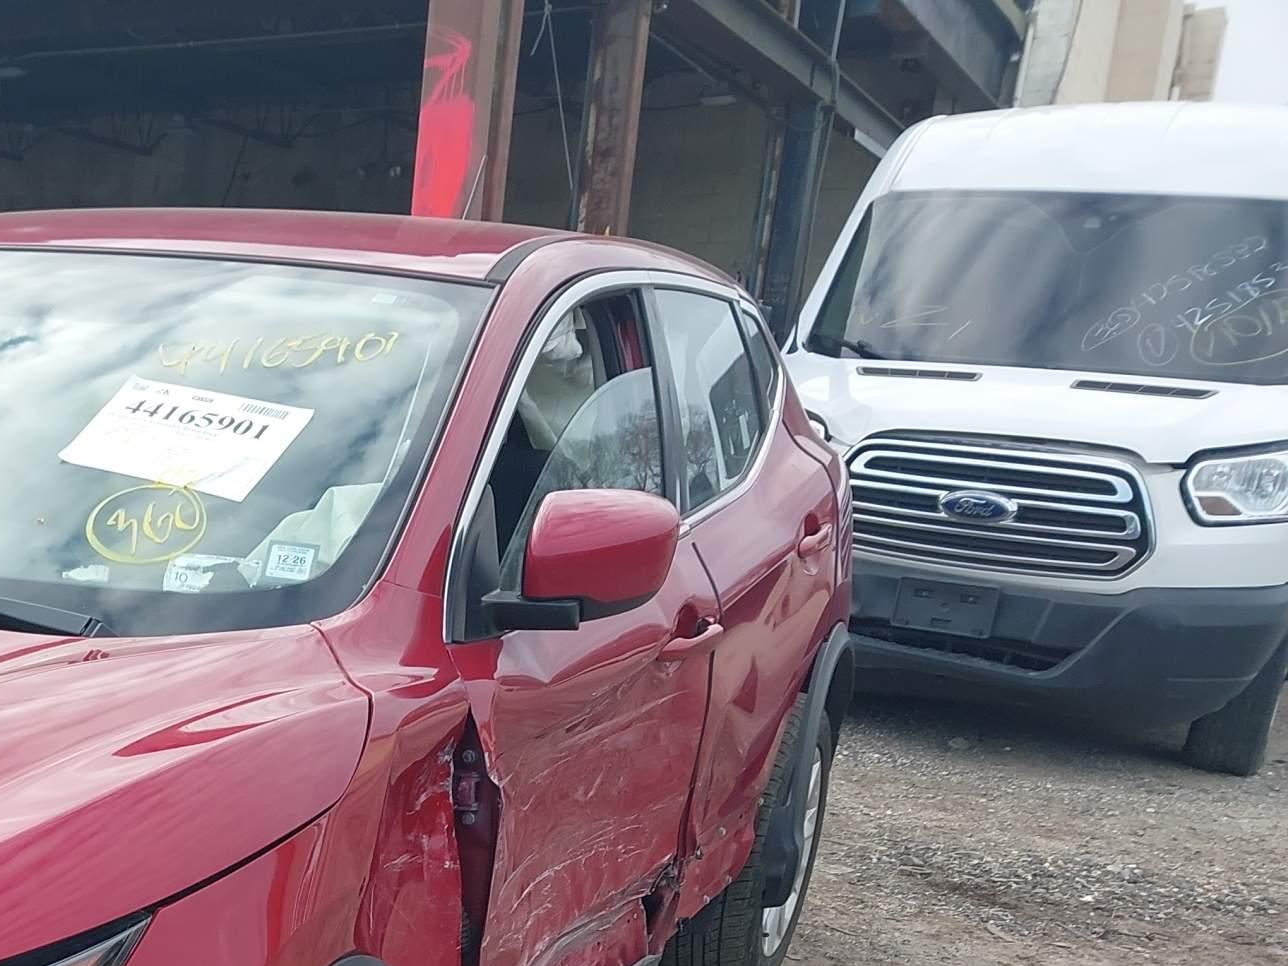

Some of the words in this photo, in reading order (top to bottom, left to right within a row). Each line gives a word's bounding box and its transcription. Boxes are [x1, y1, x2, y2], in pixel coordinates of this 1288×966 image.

[125, 400, 270, 440] 44165901
[954, 497, 995, 517] Ford
[277, 554, 290, 564] 12
